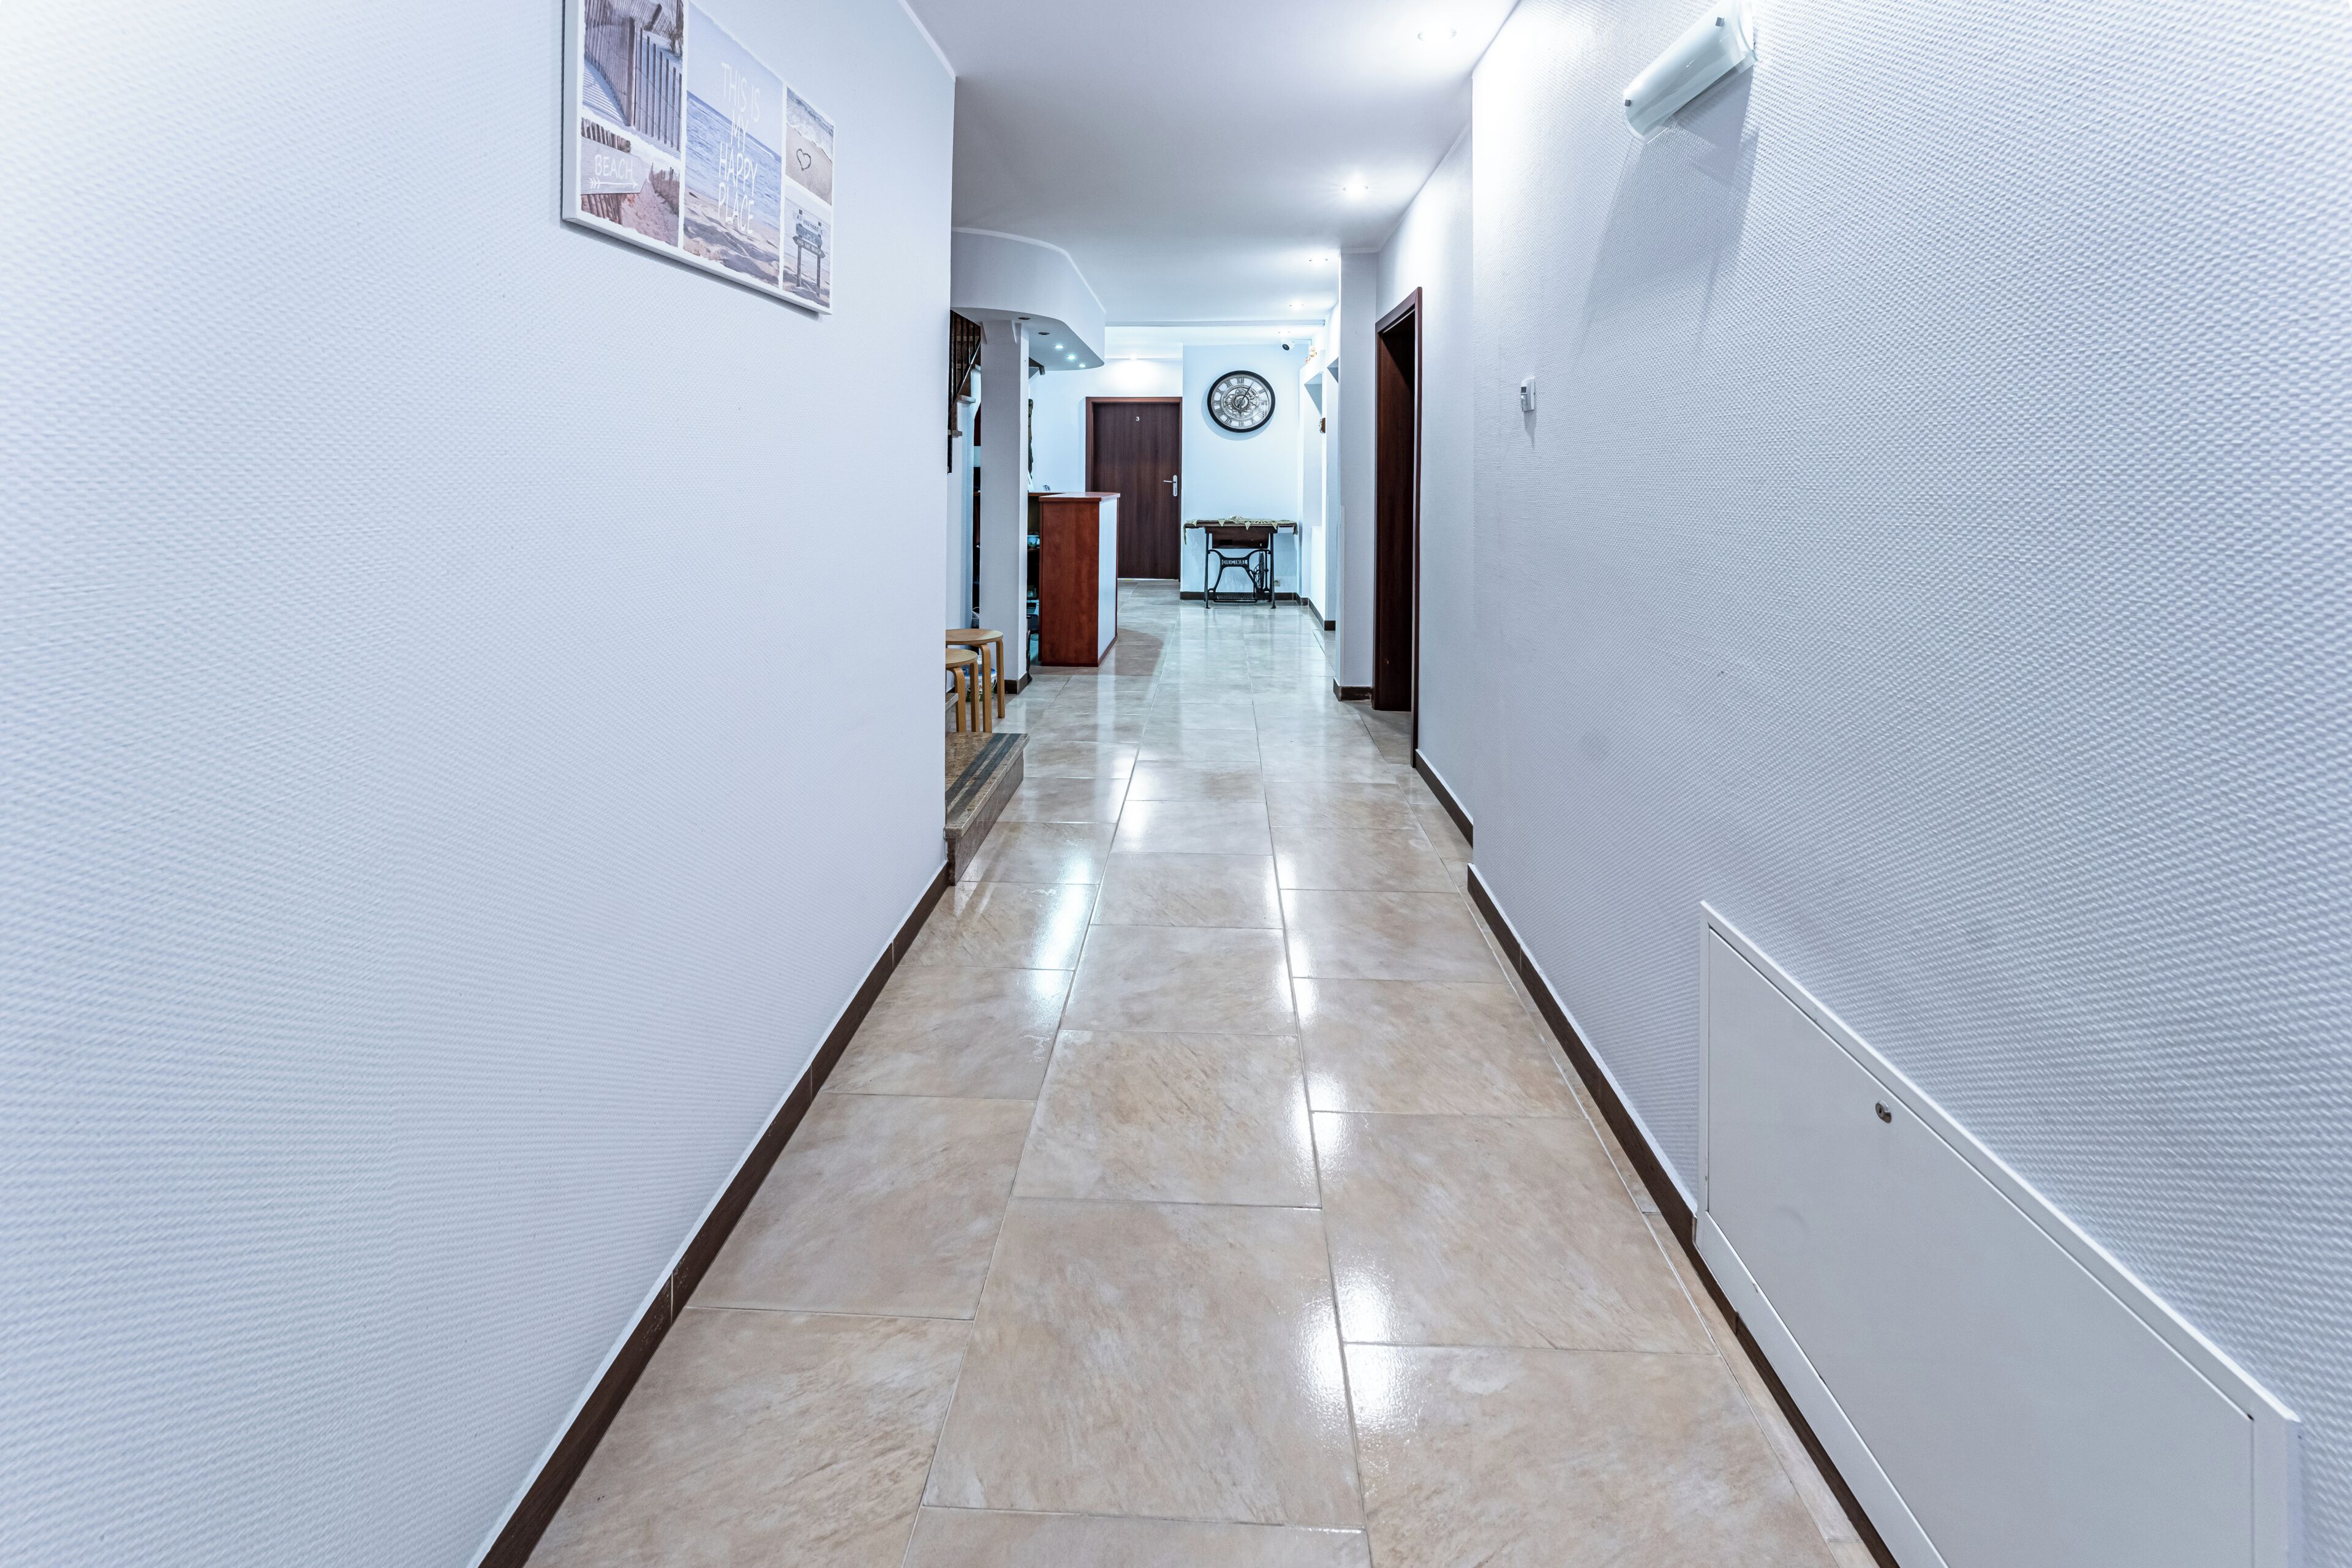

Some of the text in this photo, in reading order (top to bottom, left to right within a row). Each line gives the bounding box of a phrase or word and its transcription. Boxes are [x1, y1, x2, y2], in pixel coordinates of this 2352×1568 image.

[722, 62, 760, 122] THIS IS
[731, 108, 748, 153] MY
[595, 154, 633, 180] BEACH
[719, 141, 758, 196] HAPPY
[718, 183, 754, 234] PLACE
